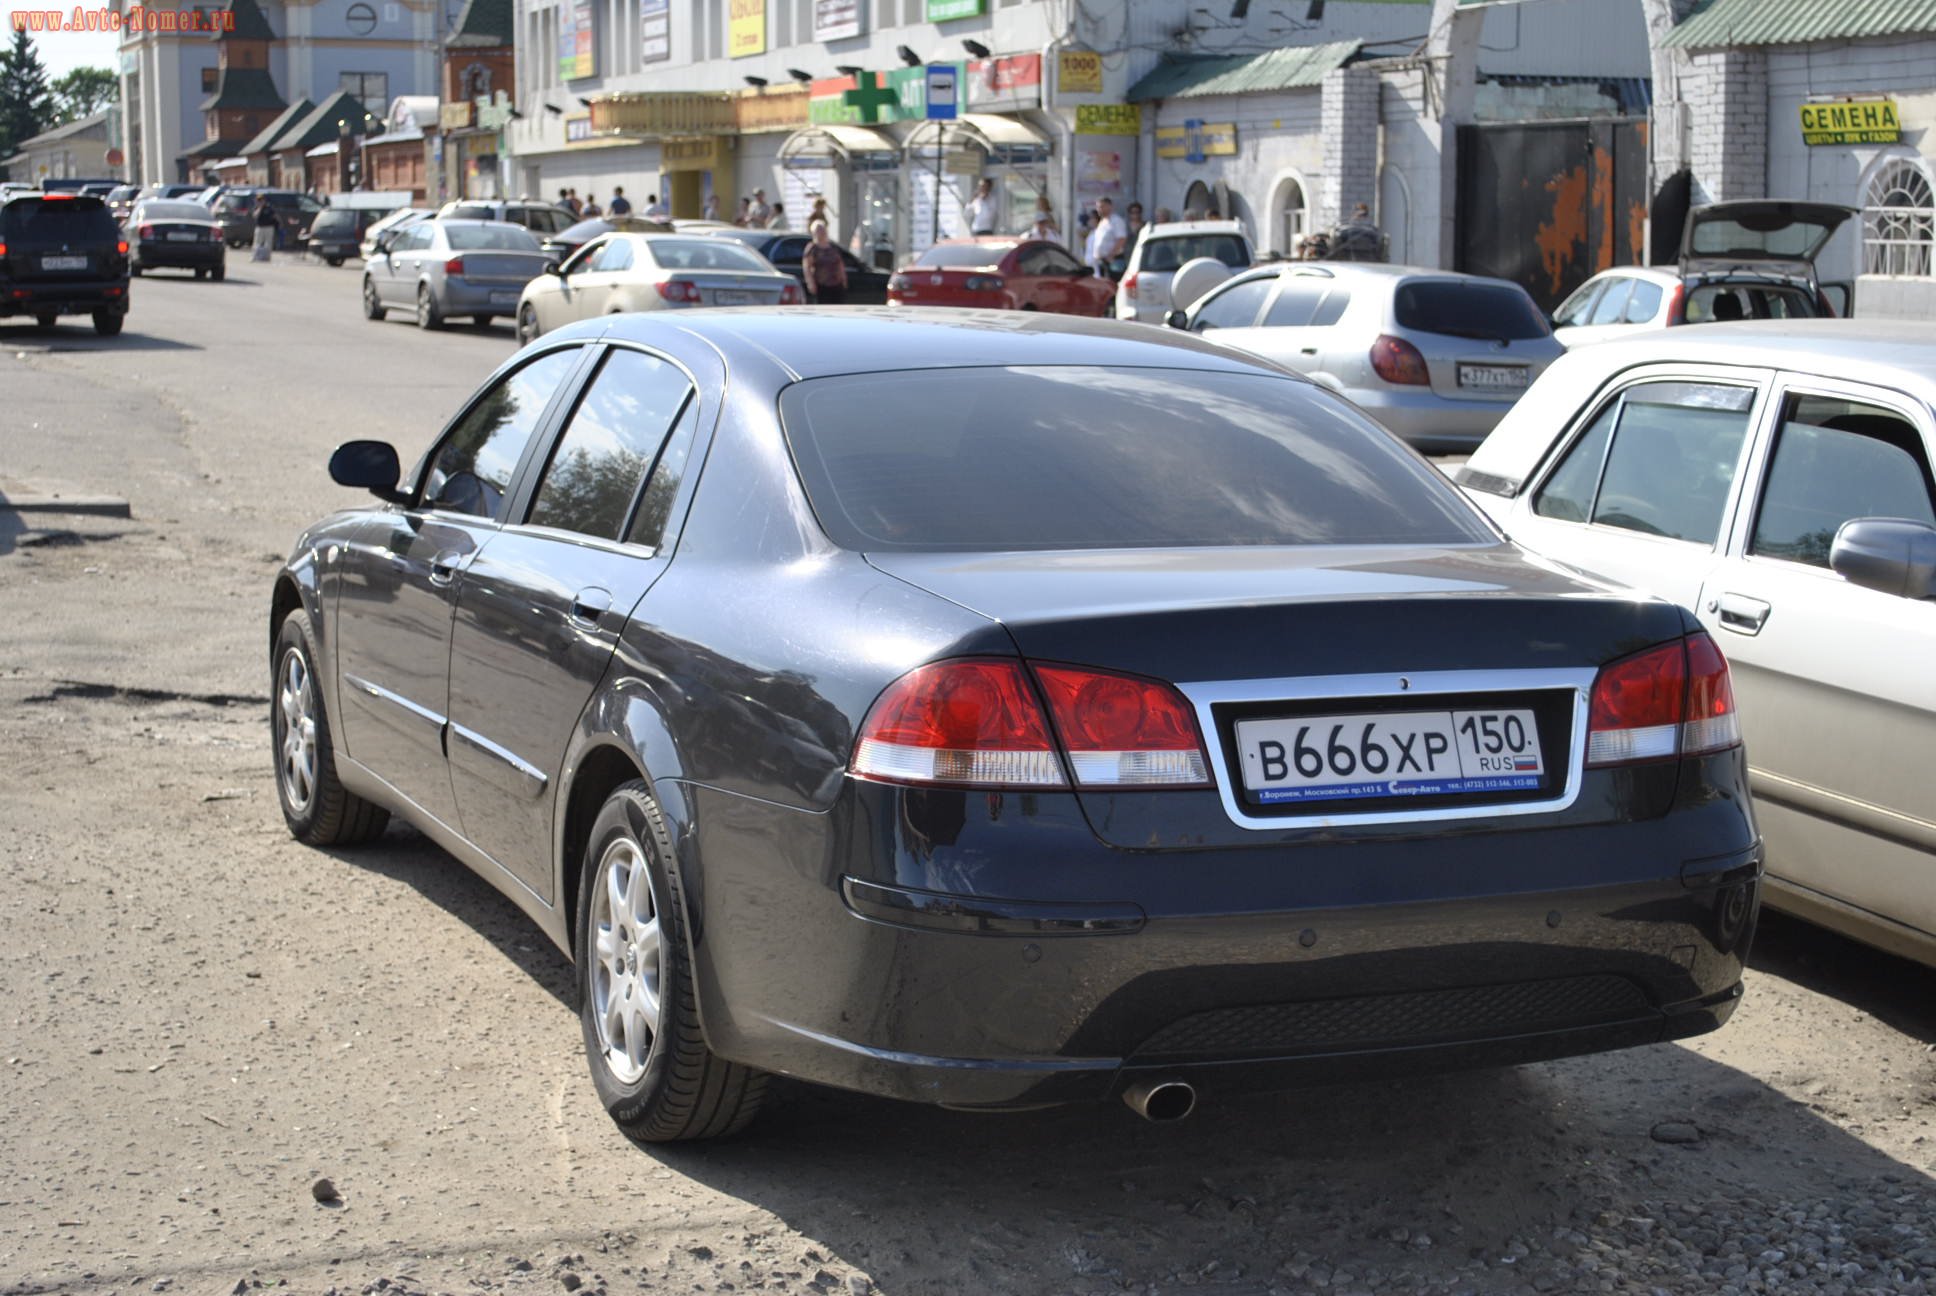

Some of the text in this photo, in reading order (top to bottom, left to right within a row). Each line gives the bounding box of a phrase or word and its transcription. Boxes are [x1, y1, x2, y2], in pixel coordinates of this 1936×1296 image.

[1077, 104, 1138, 124] СЕМЕНА
[1801, 105, 1896, 129] СЕМЕНА
[1868, 131, 1898, 143] ГАЗОН
[1259, 714, 1525, 781] В666ХР 150
[1480, 756, 1513, 771] RUS
